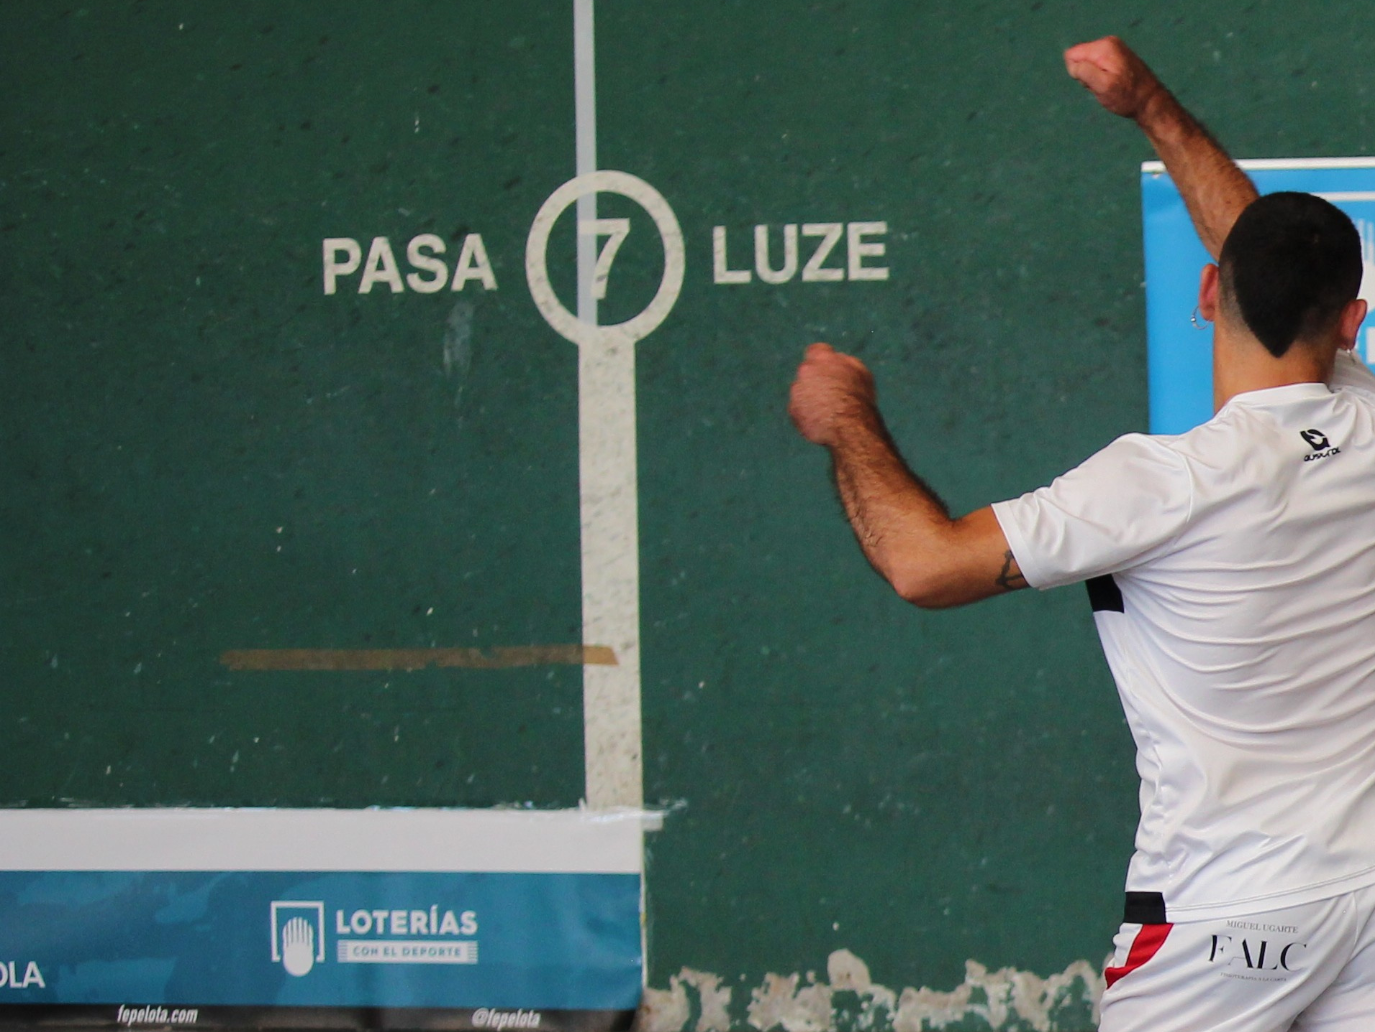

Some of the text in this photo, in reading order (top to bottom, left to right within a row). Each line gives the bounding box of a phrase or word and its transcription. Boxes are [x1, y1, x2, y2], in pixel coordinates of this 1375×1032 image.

[323, 217, 889, 300] PASA 7 LUZE
[336, 904, 478, 935] LOTERÍAS
[1226, 920, 1298, 934] MIGUEL UGARTE
[383, 945, 396, 957] EL
[402, 945, 461, 957] DEPORTE
[1208, 934, 1307, 972] FALC
[116, 1004, 199, 1027] fepelota.com
[471, 1007, 542, 1032] @fepelota
